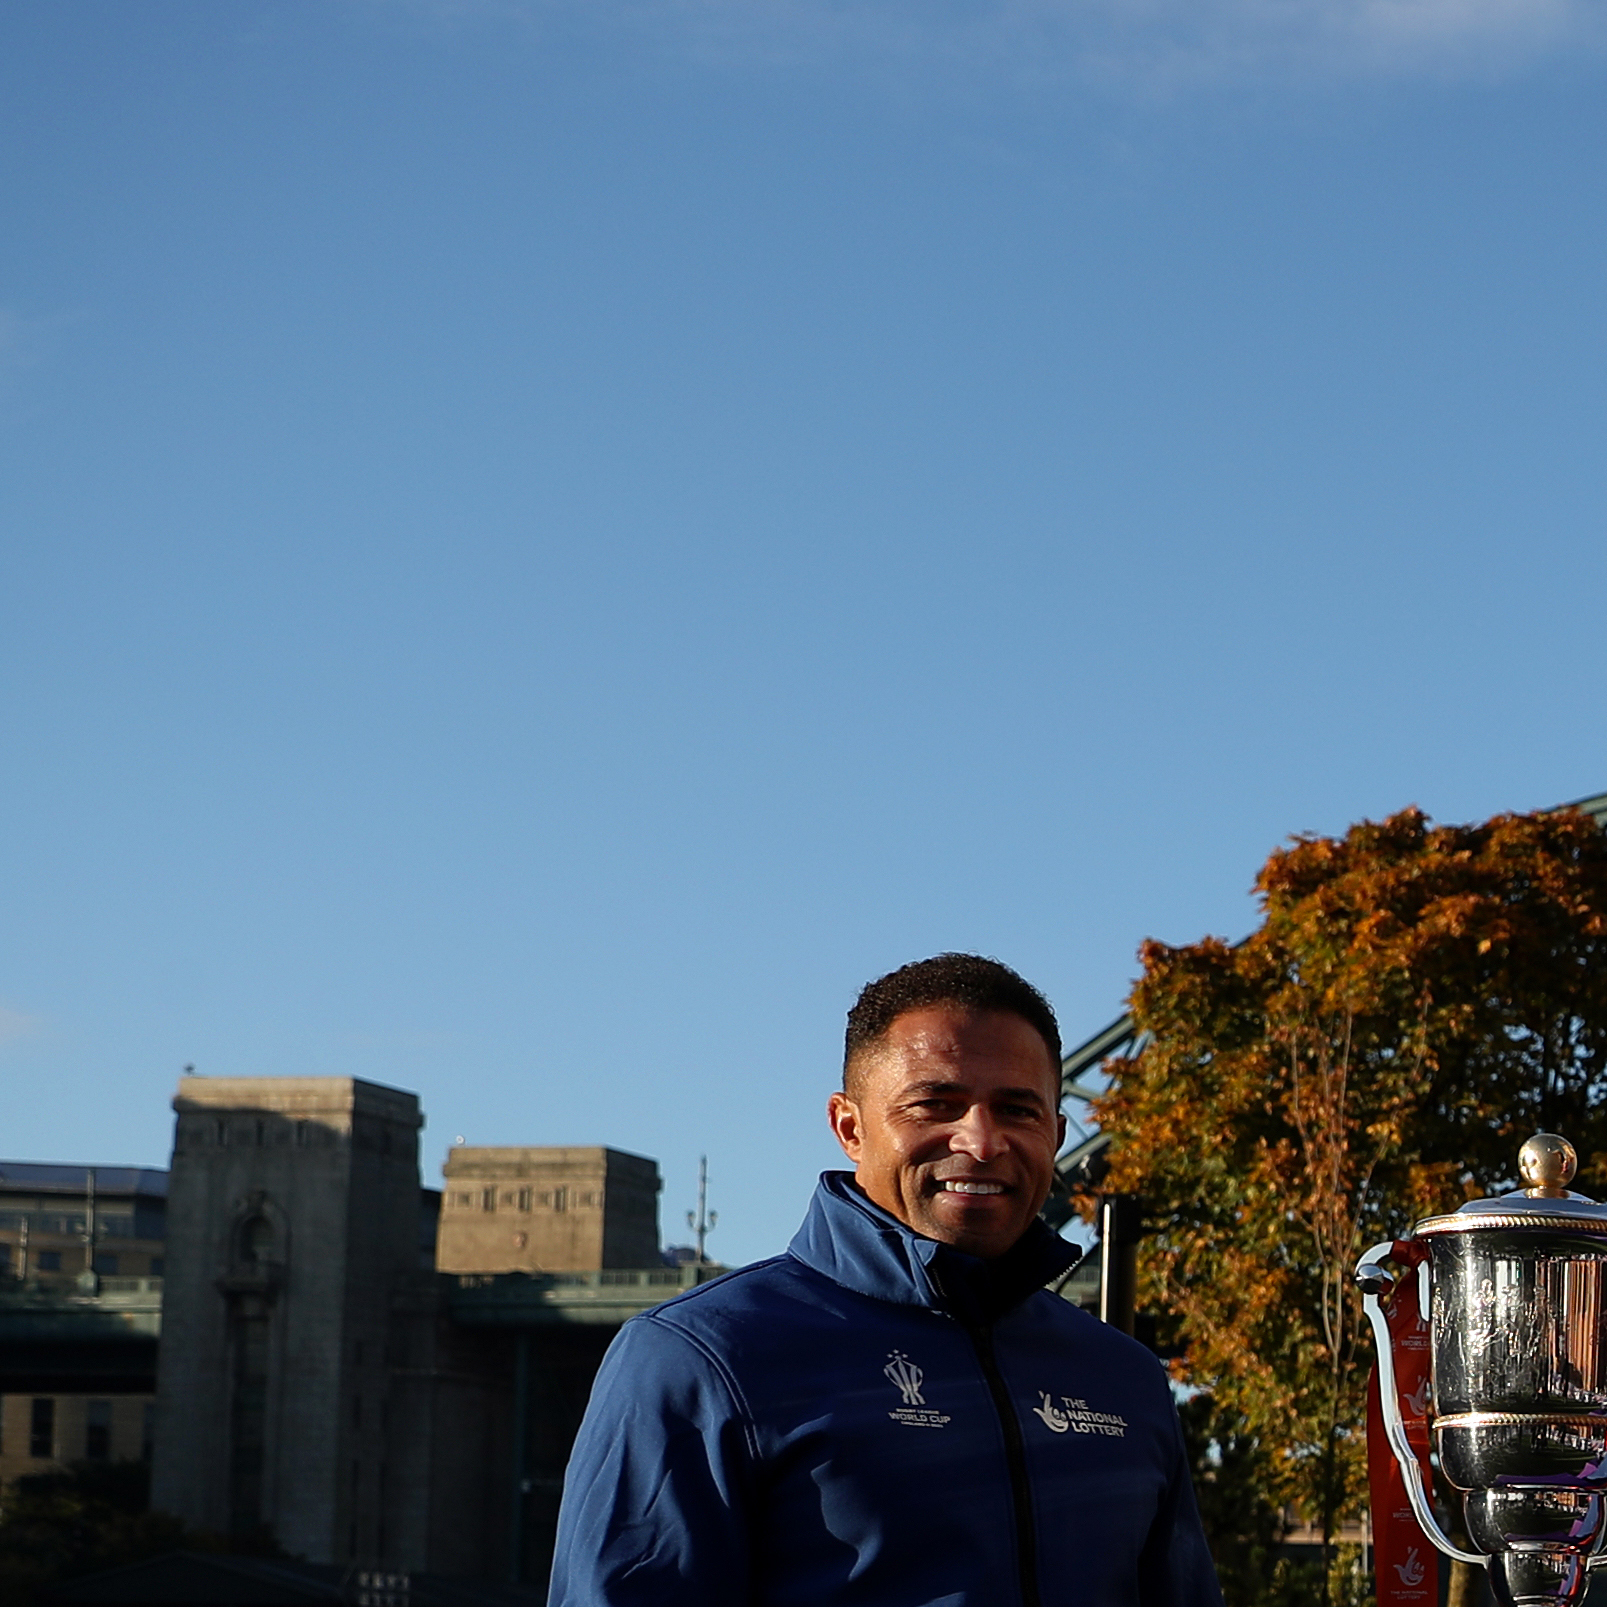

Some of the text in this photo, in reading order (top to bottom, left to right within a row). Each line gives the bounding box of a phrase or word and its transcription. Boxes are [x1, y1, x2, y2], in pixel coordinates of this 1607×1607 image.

[1061, 1396, 1089, 1410] THE
[888, 1411, 929, 1422] WORLD
[929, 1414, 952, 1424] CUP
[1066, 1409, 1129, 1427] NATIONAL
[1071, 1421, 1125, 1438] LOTTERY
